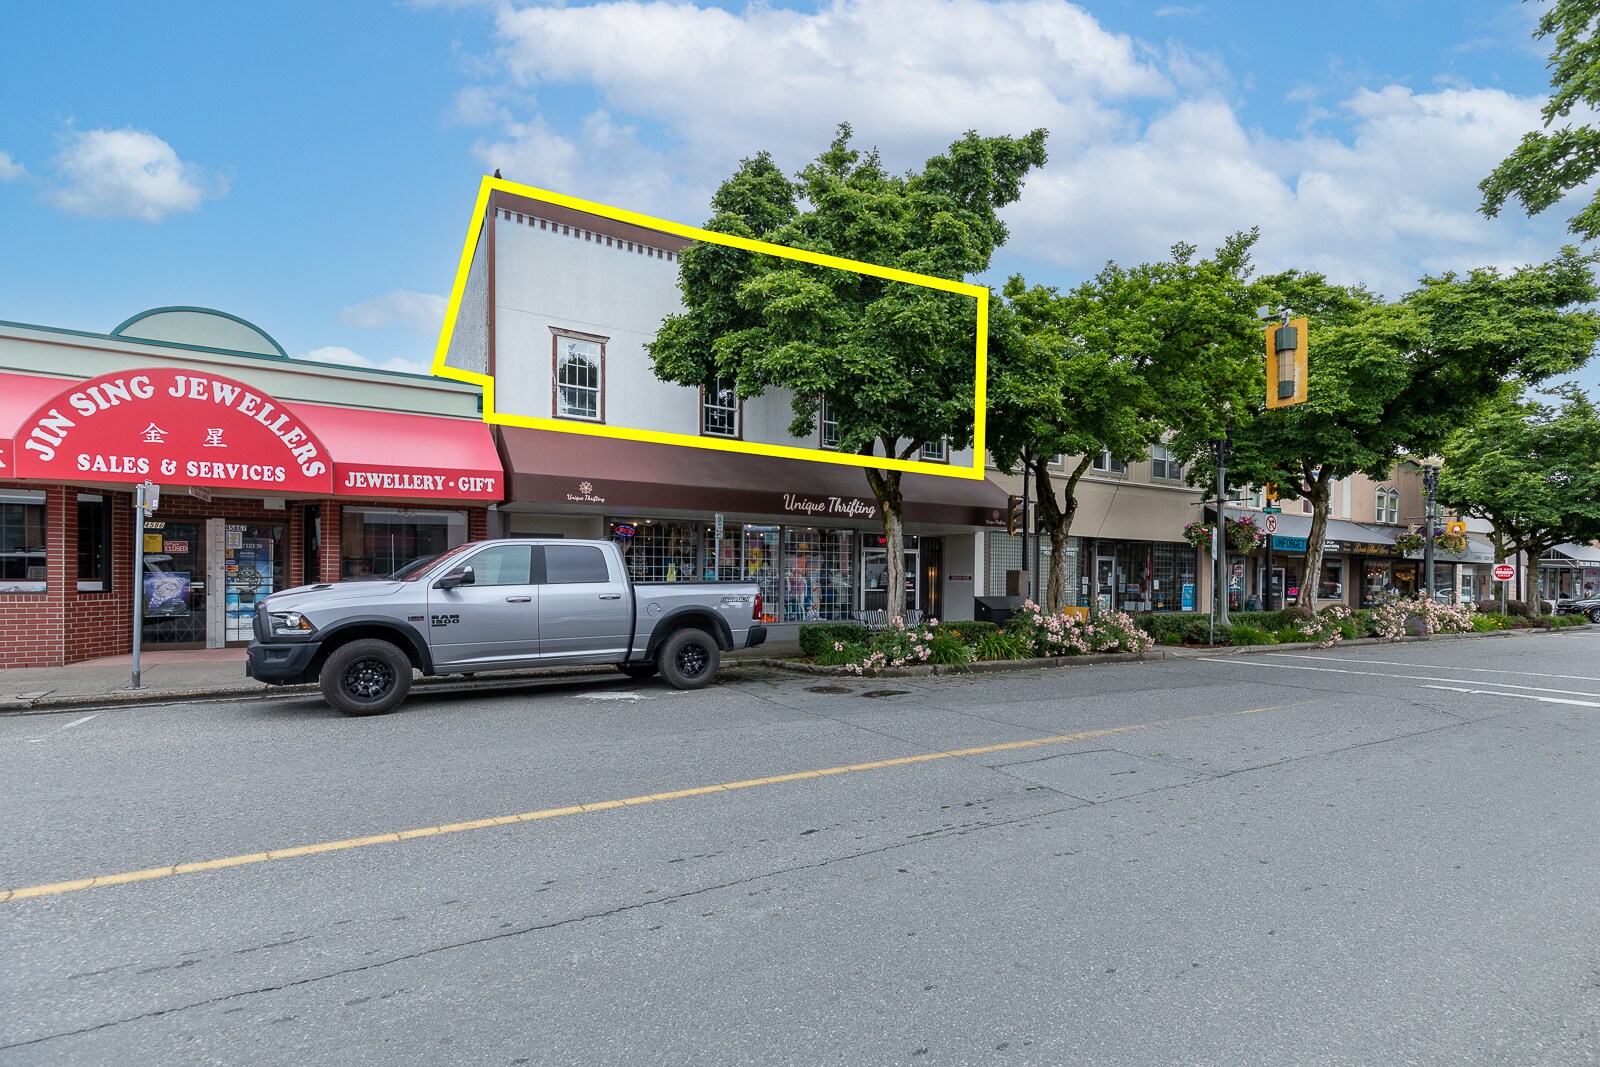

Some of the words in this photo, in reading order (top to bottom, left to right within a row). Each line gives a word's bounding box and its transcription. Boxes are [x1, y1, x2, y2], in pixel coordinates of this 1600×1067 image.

[25, 409, 75, 461] JIN
[69, 376, 155, 417] SING
[168, 375, 326, 477] JEWELLERS
[140, 423, 169, 444] 金
[203, 428, 228, 448] 星
[78, 454, 150, 475] SALES
[161, 459, 177, 476] &
[186, 461, 286, 483] SERVICES
[345, 471, 445, 491] JEWELLERY
[458, 476, 495, 493] GIFT
[566, 493, 584, 501] Unique
[584, 494, 605, 503] Thrifting
[783, 493, 826, 515] Unique
[828, 496, 877, 519] Thrifting
[615, 527, 635, 535] OPEN
[1275, 537, 1306, 549] UNFORGET
